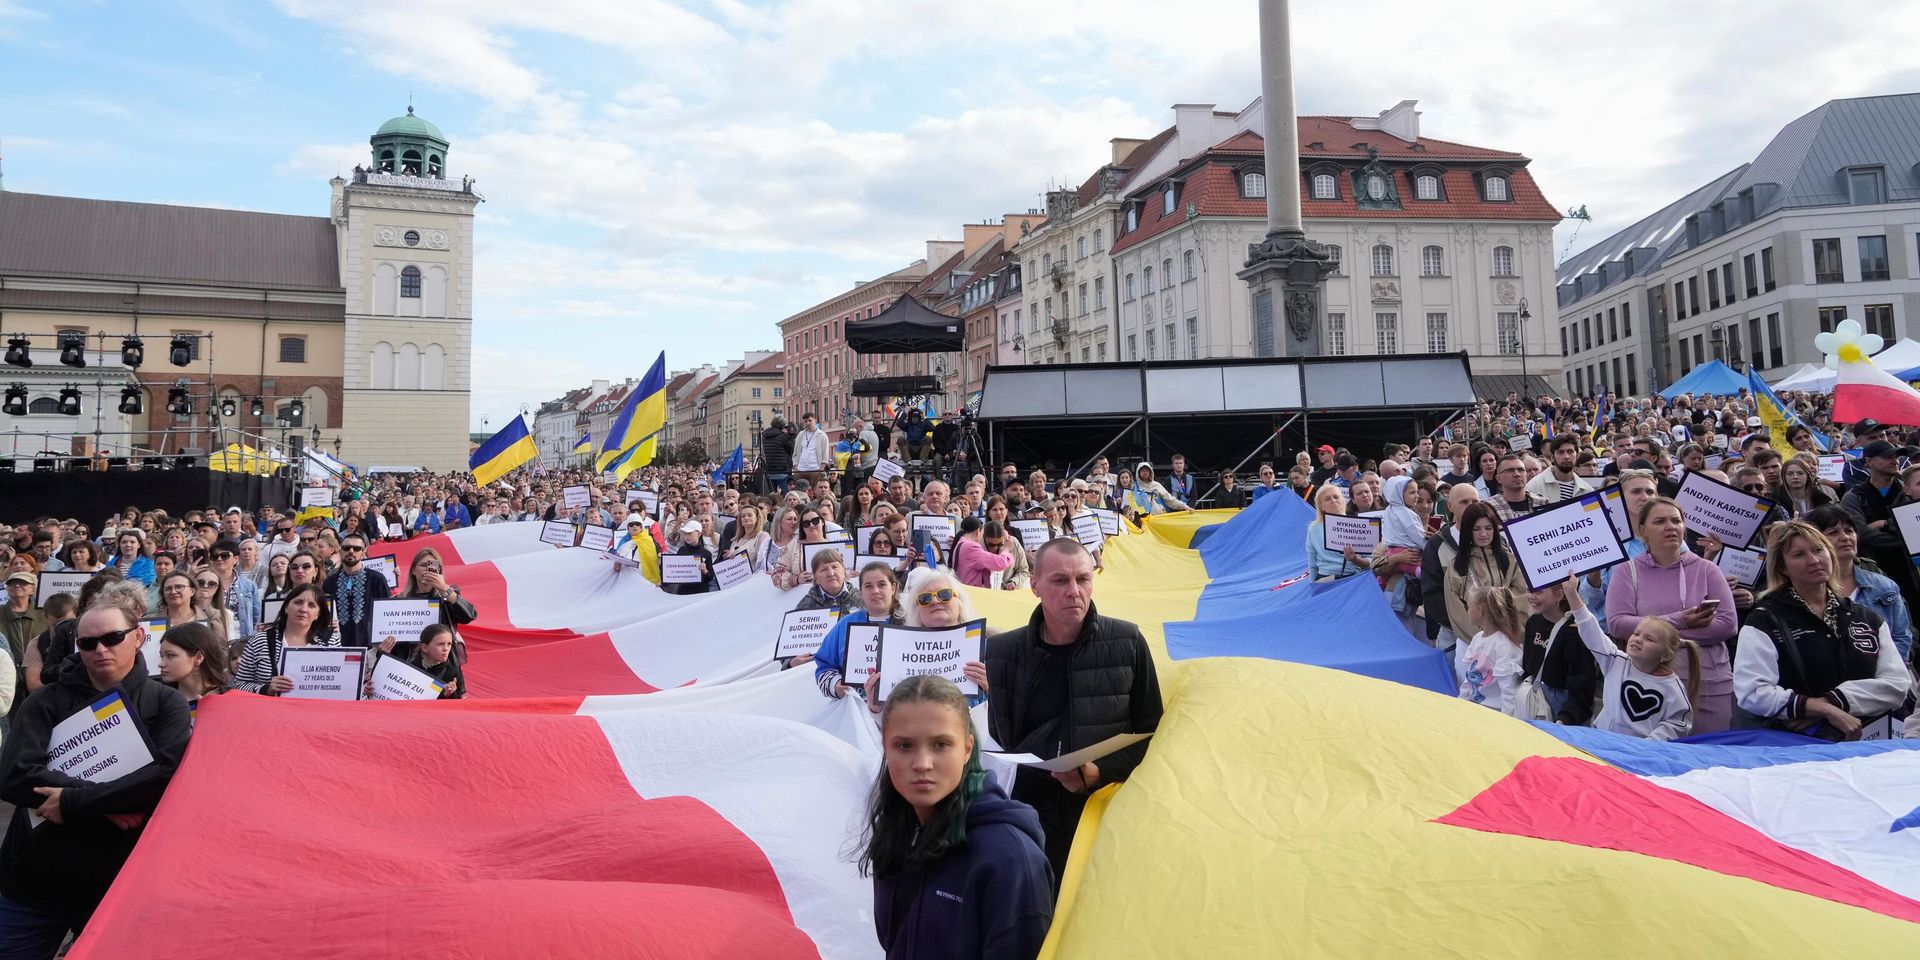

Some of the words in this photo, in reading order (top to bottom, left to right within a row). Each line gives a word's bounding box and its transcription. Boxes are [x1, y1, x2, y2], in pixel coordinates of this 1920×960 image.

[371, 174, 399, 182] TARAS
[1683, 486, 1716, 506] ANDRII
[1717, 500, 1760, 521] KARATSAI
[1336, 521, 1367, 529] MYKHAILO
[1682, 512, 1702, 524] ILLED
[1702, 521, 1711, 529] BY
[1711, 525, 1743, 539] RUSSIANS
[1694, 505, 1703, 513] 33
[1703, 509, 1725, 523] YEARS
[1725, 518, 1739, 527] OLD
[1526, 528, 1559, 547] SERHII
[1560, 517, 1594, 536] ZAIATS
[1543, 549, 1553, 557] 41
[1553, 541, 1575, 554] YEARS
[1575, 536, 1591, 546] OLD
[1537, 561, 1562, 575] KILLED
[1562, 557, 1571, 566] BY
[1571, 545, 1609, 563] RUSSIANS
[789, 622, 828, 632] BUDCHENKO
[864, 644, 879, 652] VLA
[914, 640, 952, 651] VITALII
[1848, 621, 1880, 655] S
[902, 649, 961, 663] HORBARUK
[315, 665, 342, 673] KHRENOV
[906, 668, 915, 676] 31
[917, 668, 943, 676] YEARS
[943, 664, 957, 673] OLD
[386, 672, 412, 688] NAZAR
[411, 683, 425, 695] ZUI
[951, 676, 968, 684] IANS
[387, 685, 404, 697] YEARS
[47, 714, 121, 762] ROSHNYCHENKO
[59, 754, 84, 772] YEARS
[84, 746, 99, 760] OLD
[82, 754, 119, 780] RUSSIANS
